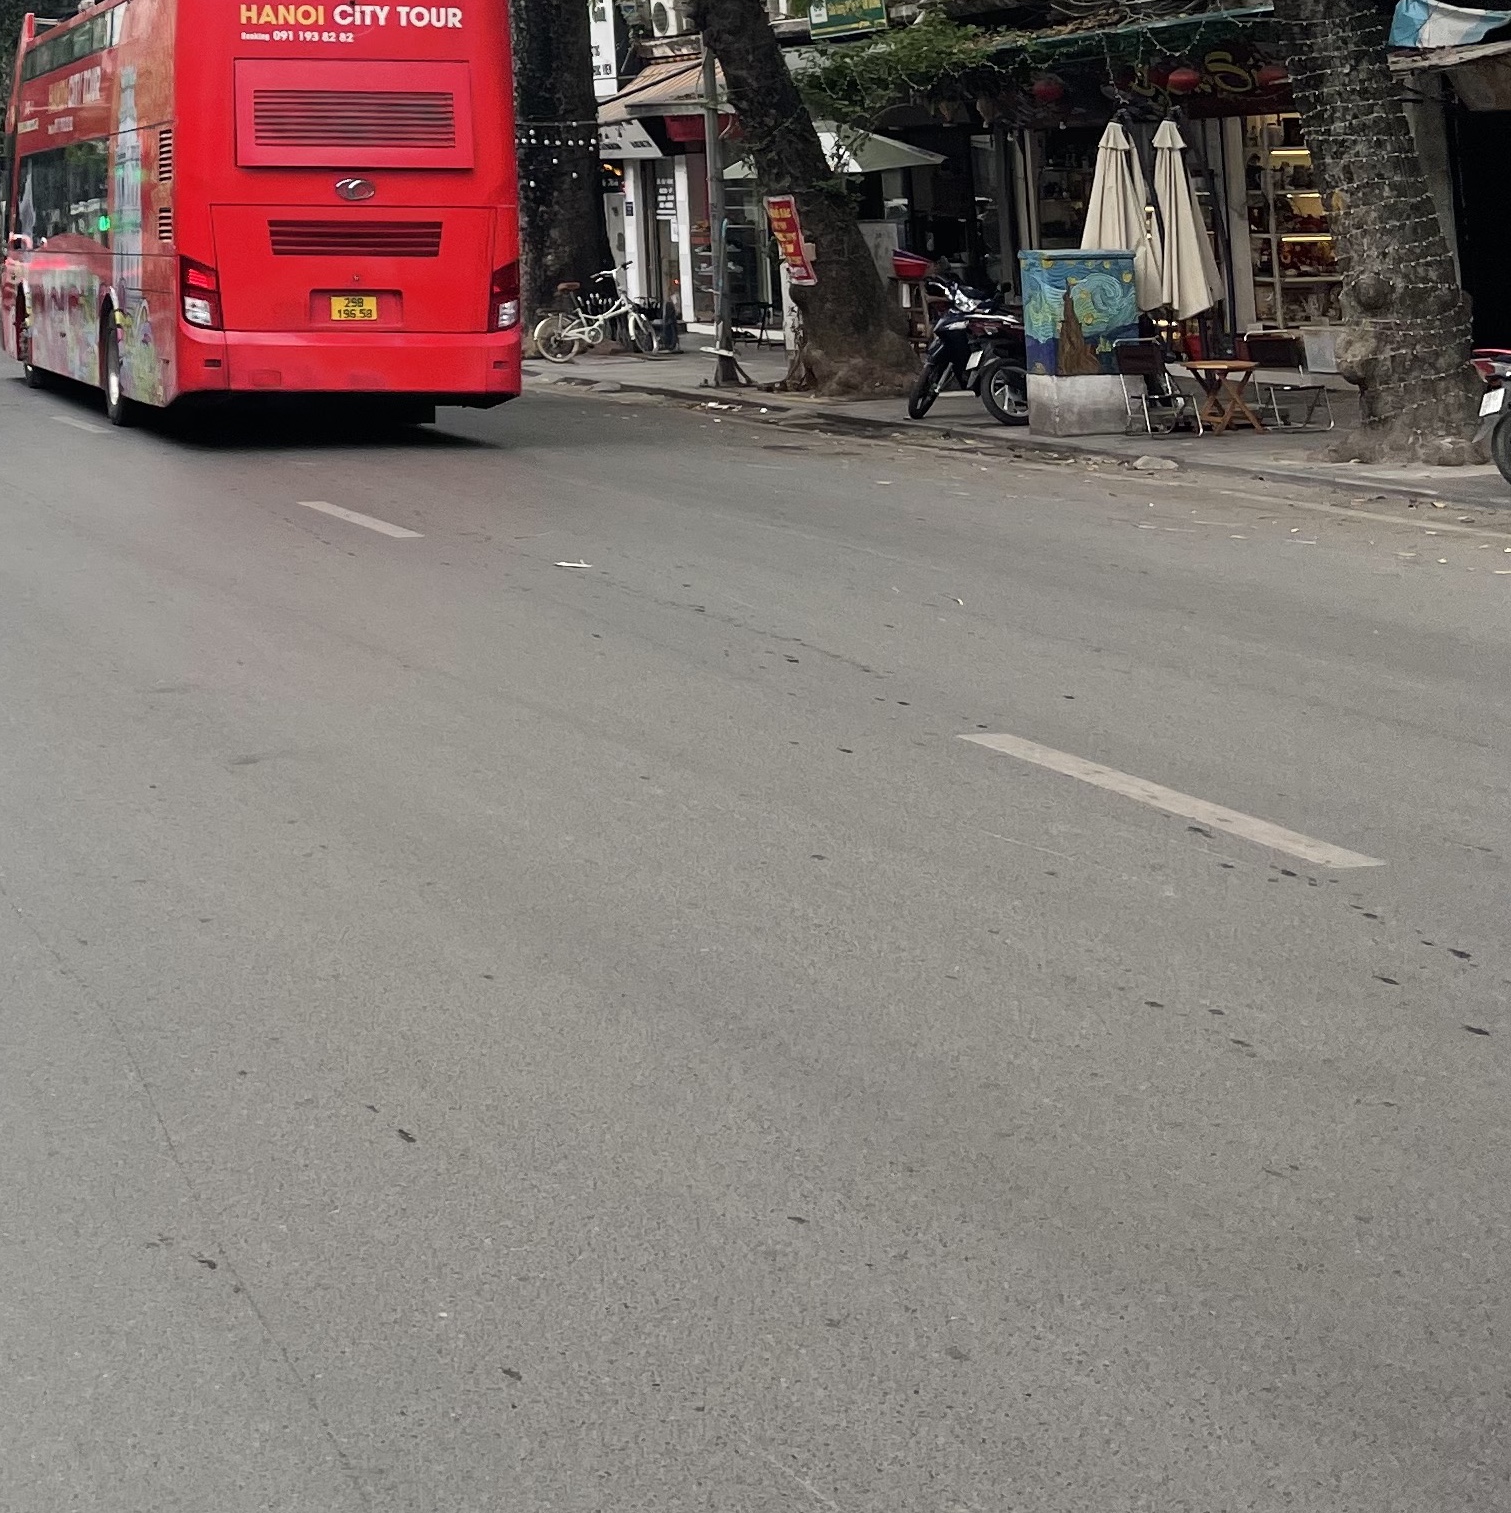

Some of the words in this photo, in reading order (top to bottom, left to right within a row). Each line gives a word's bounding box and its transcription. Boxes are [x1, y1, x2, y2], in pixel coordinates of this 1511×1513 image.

[240, 4, 325, 26] HANOI
[396, 6, 463, 29] TOUR
[273, 31, 294, 42] 091
[298, 31, 319, 42] 193
[321, 32, 336, 43] 82
[339, 32, 354, 43] 82
